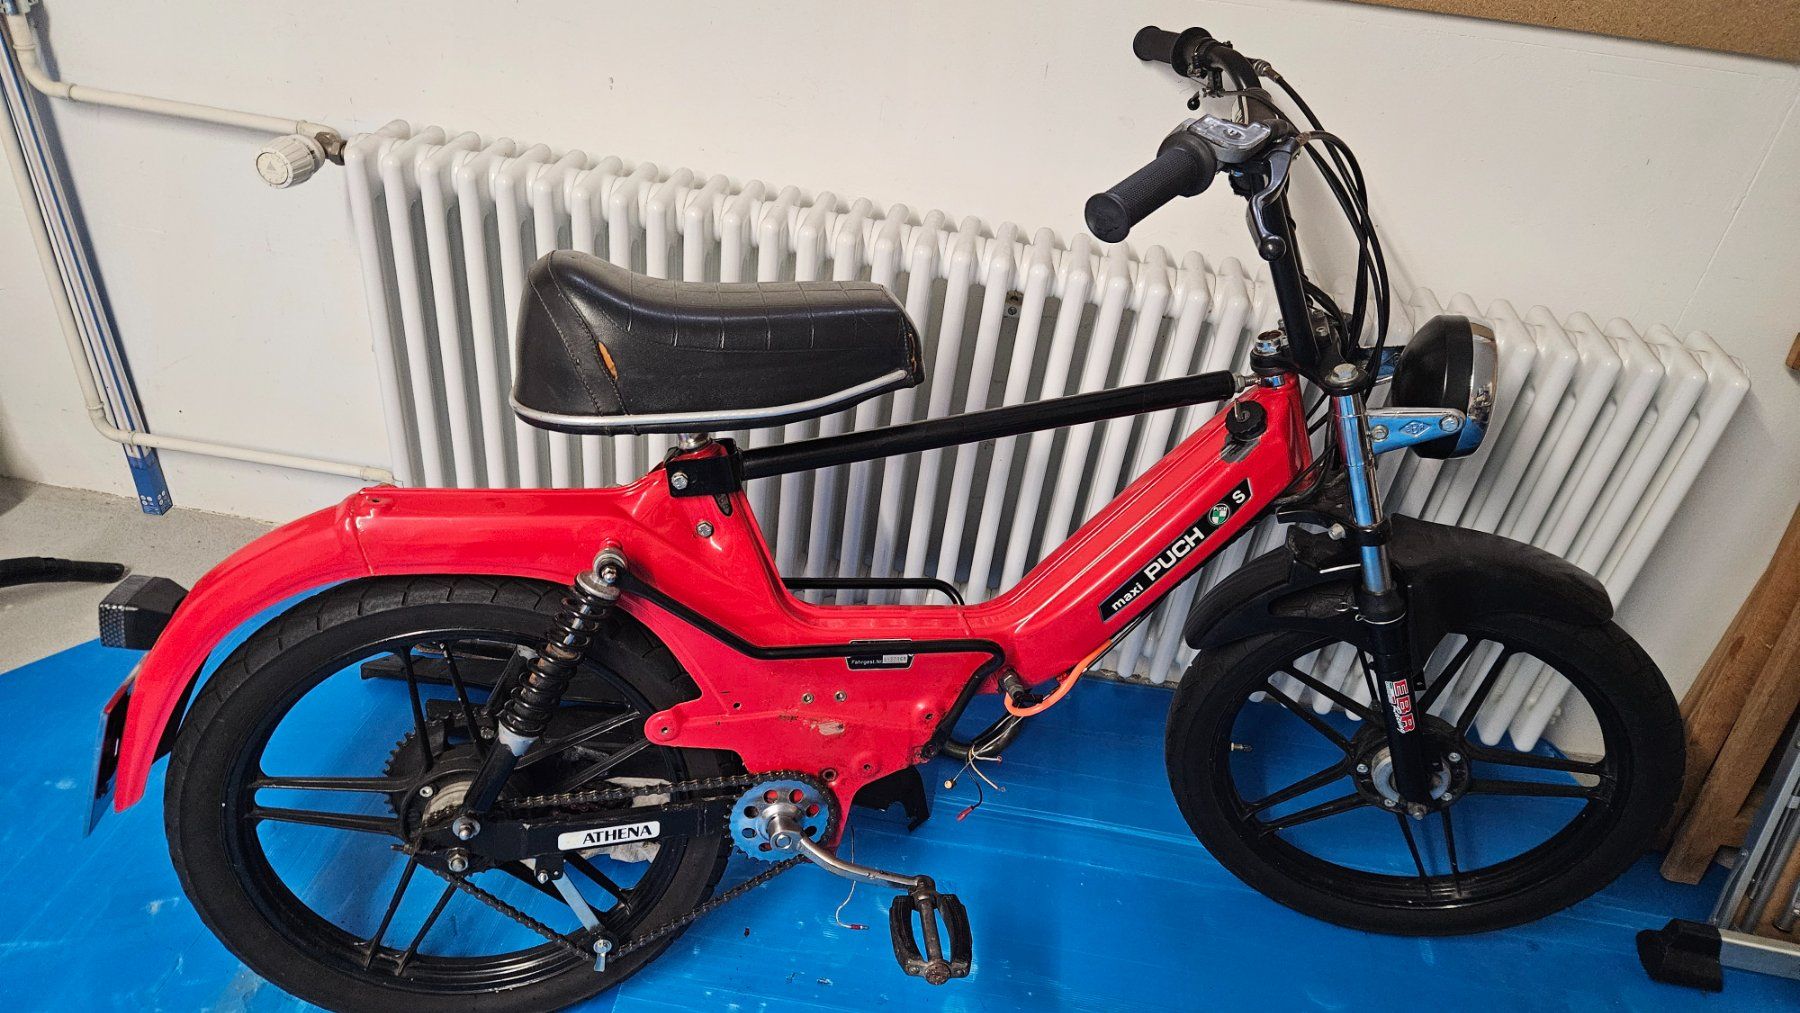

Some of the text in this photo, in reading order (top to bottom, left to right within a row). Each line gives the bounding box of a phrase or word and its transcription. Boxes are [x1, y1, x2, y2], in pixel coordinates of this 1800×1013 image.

[1111, 490, 1246, 611] maxi PUCH S
[1393, 679, 1415, 732] EBR
[583, 825, 652, 844] ATHENA
